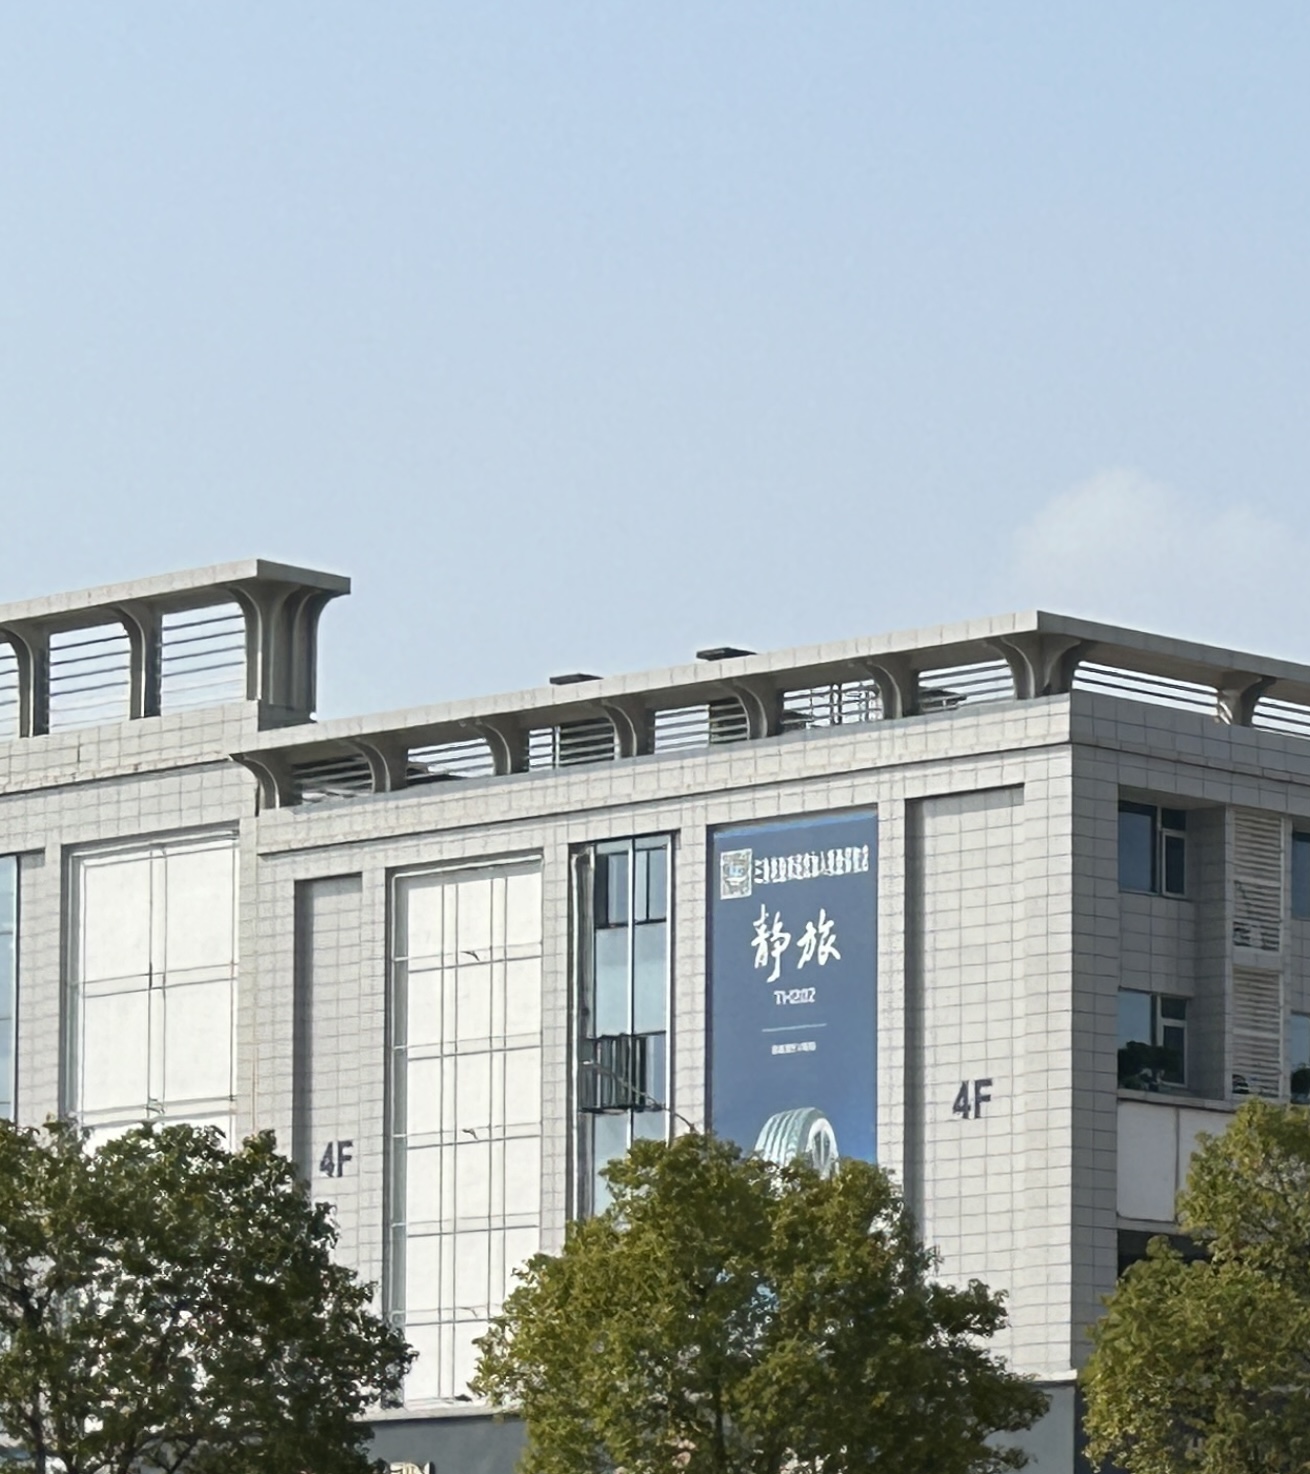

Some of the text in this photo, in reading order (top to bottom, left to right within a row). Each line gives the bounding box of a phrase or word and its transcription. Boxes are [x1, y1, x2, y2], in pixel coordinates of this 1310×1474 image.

[751, 903, 841, 983] 静旅
[951, 1078, 994, 1120] 4F
[319, 1140, 353, 1178] 4F
